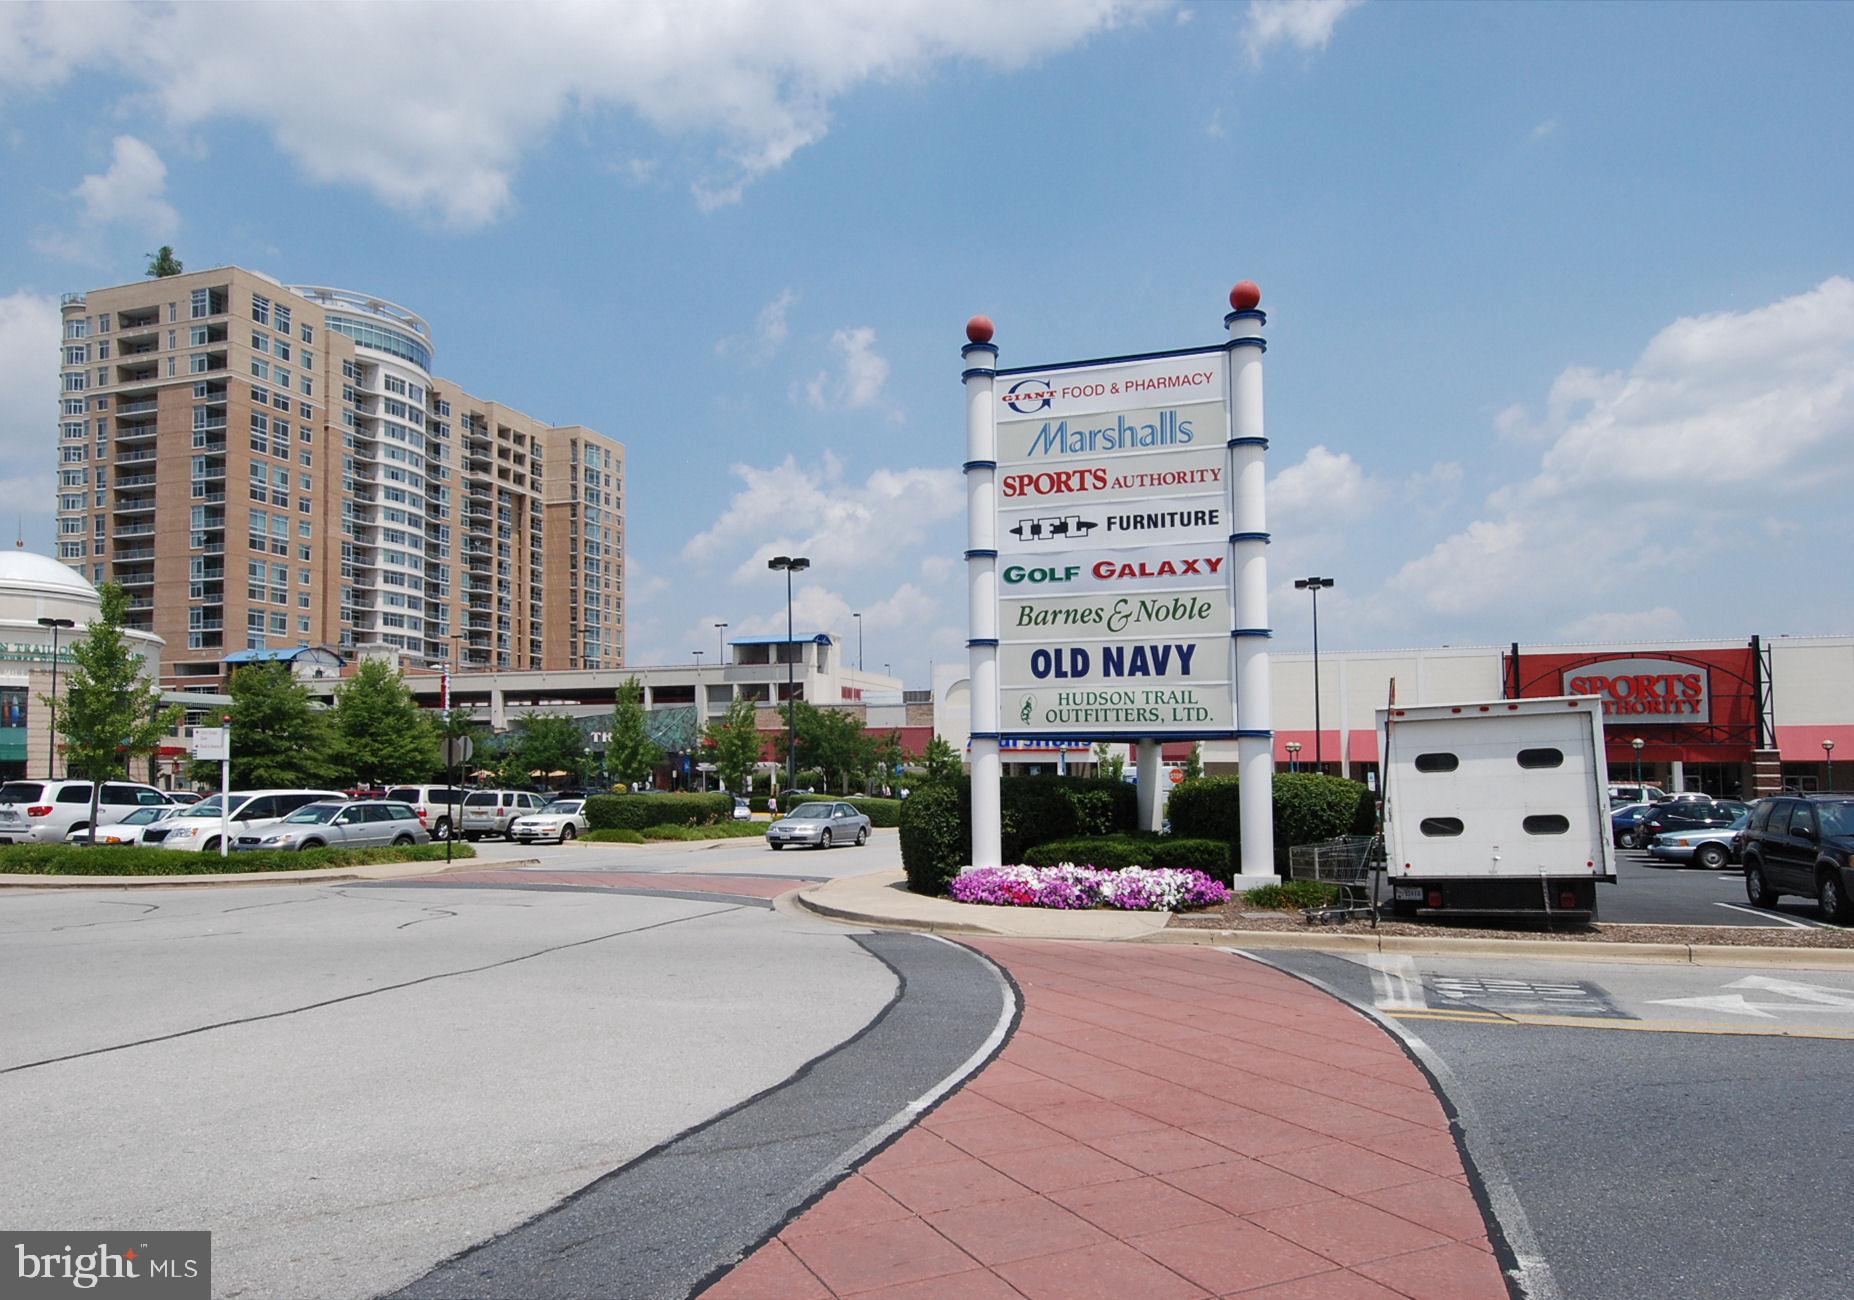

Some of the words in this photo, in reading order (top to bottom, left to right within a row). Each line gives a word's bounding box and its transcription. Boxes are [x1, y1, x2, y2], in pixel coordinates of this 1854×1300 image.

[1002, 390, 1056, 402] GIANT
[1062, 384, 1105, 399] FOOD
[1110, 381, 1120, 394] &
[1126, 372, 1214, 392] PHARMACY
[1027, 410, 1194, 457] Marshalls
[1003, 468, 1107, 497] SPORTS
[1111, 468, 1221, 489] AUTHORITY
[1019, 515, 1089, 541] IFL
[1106, 509, 1219, 531] FURNITURE
[1003, 565, 1081, 584] GOLF
[1092, 557, 1224, 580] GALAXY
[1016, 605, 1105, 627] Barnes
[1107, 598, 1133, 632] &
[1134, 597, 1211, 623] Noble
[1031, 648, 1090, 679] OLD
[1102, 644, 1196, 678] NAVY
[1058, 691, 1136, 706] HUDSON
[1142, 690, 1199, 705] TRAIL
[1570, 674, 1703, 700] SPORTS
[1045, 708, 1165, 724] OUTFITTERS,
[1172, 707, 1214, 723] LTD.
[1602, 699, 1703, 715] THORITY
